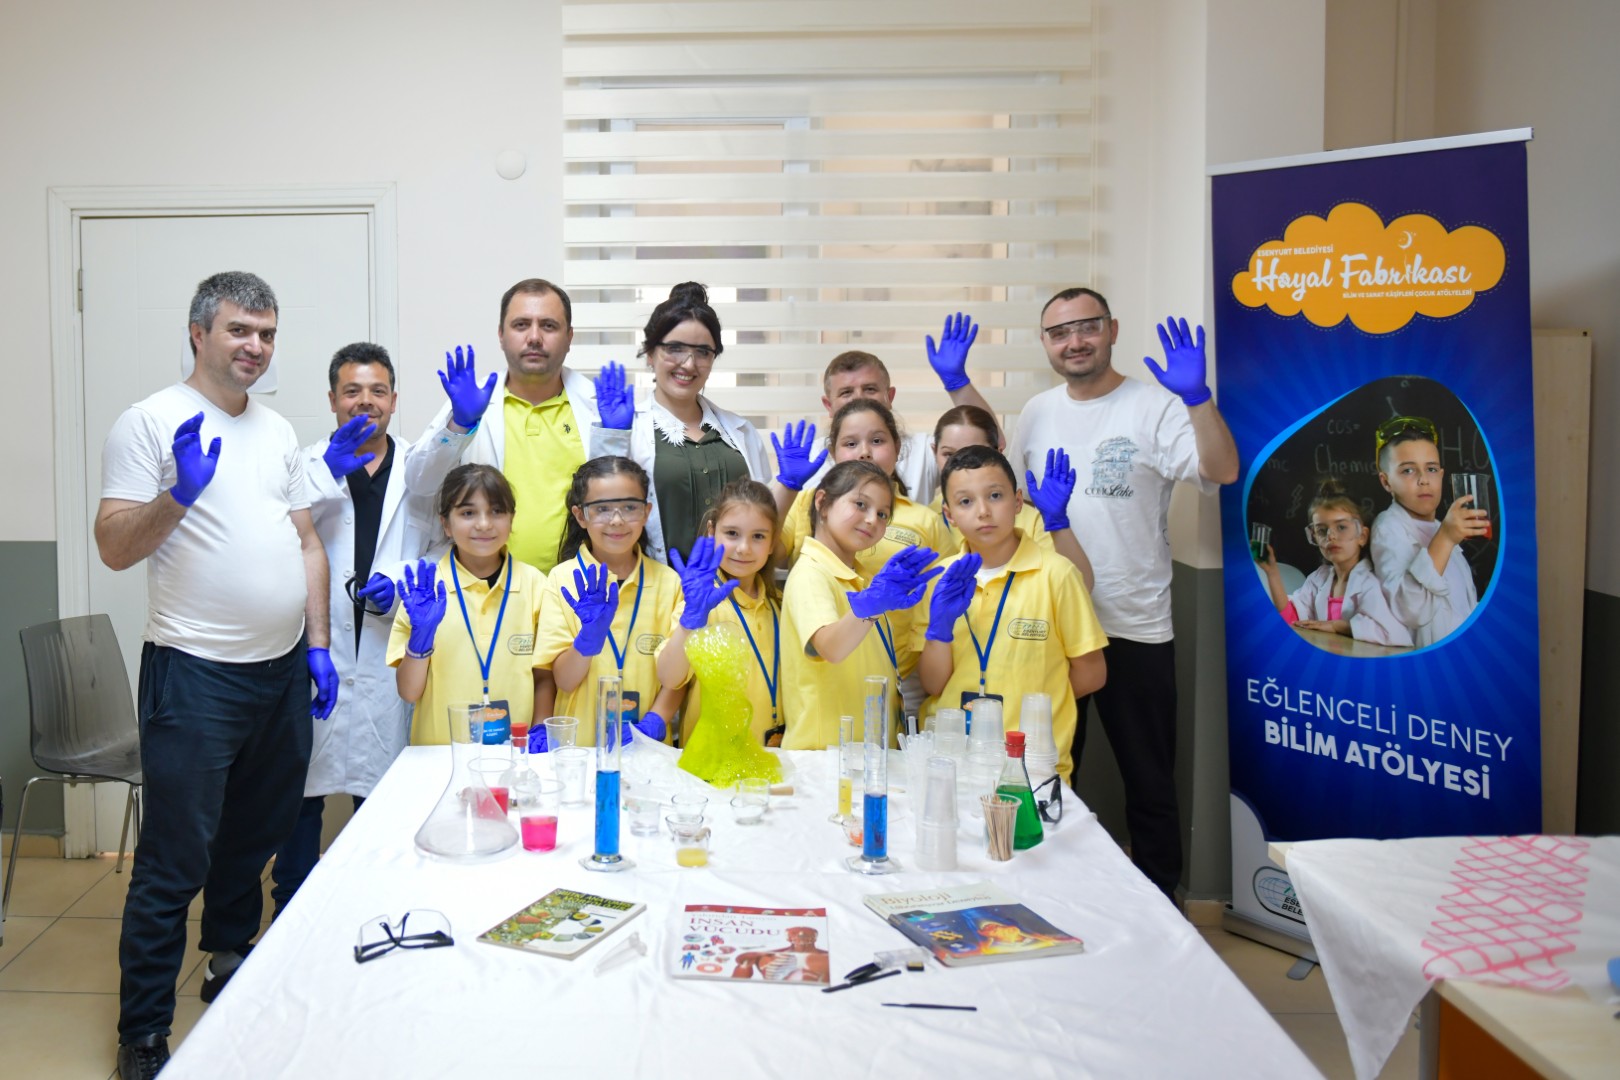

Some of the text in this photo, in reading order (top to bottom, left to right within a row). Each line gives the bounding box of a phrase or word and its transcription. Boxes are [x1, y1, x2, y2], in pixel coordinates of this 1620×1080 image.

[1251, 252, 1472, 302] Hayal Fabrikası
[1293, 244, 1334, 256] BELEDİYESİ
[1246, 677, 1513, 762] EĞLENCELİ DENEY
[1264, 716, 1491, 800] BİLİM ATÖLYESİ
